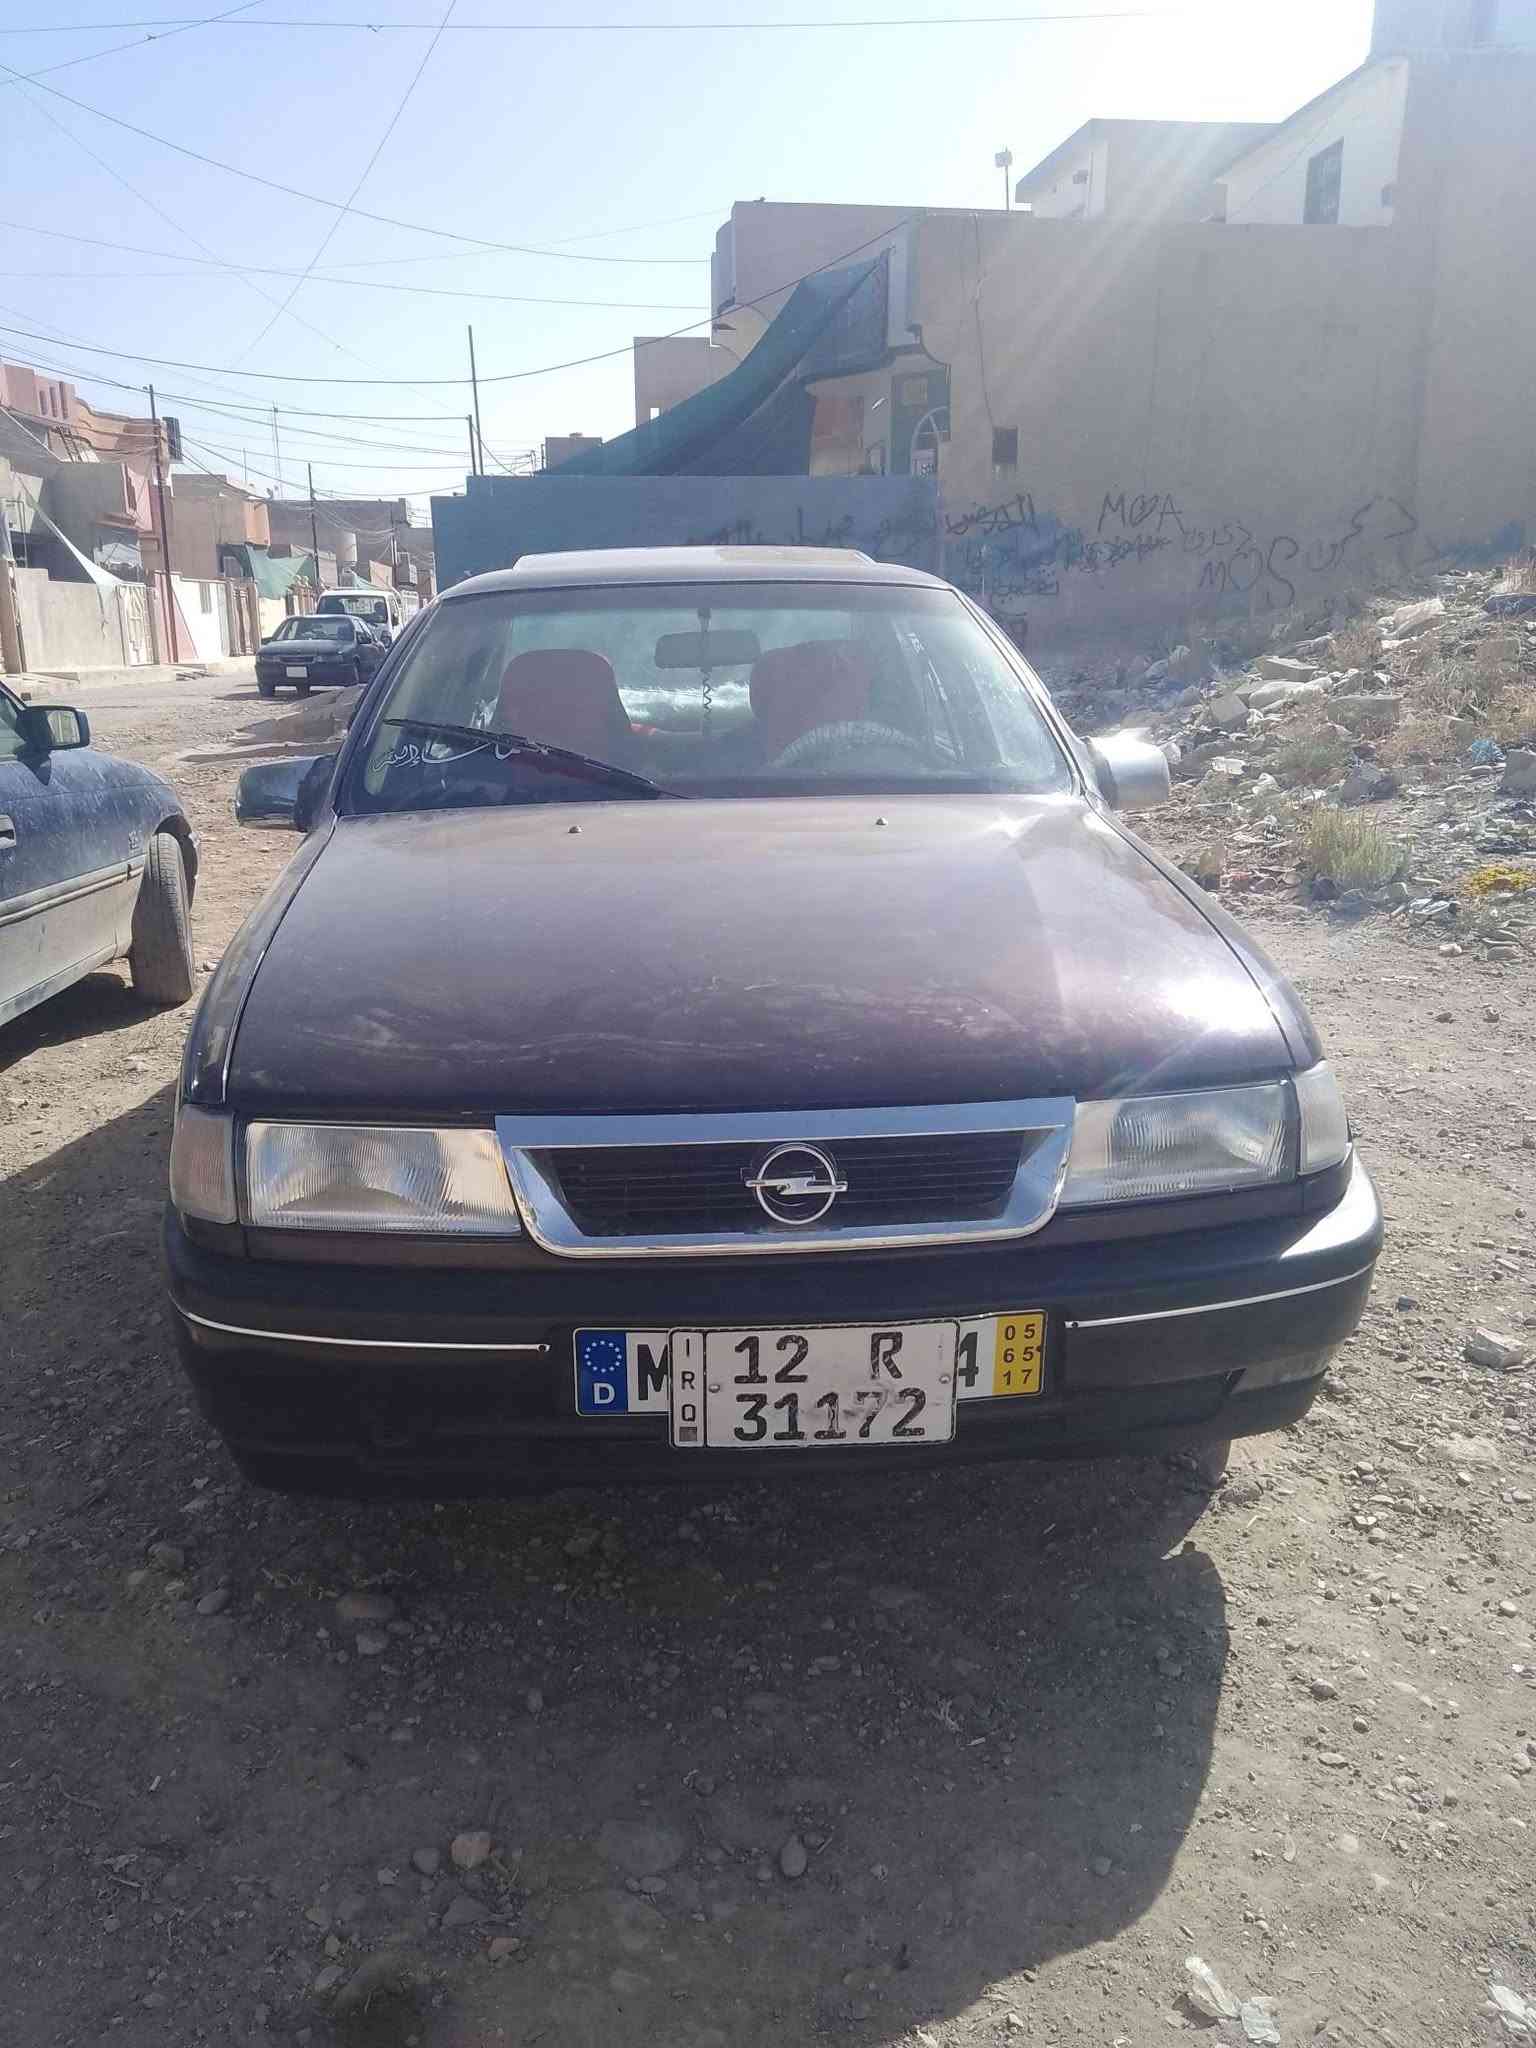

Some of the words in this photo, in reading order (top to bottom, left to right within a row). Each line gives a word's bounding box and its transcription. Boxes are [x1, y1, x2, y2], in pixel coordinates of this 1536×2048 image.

[1004, 1323, 1036, 1340] 05
[734, 1334, 809, 1384] 12
[870, 1331, 903, 1380] R
[1003, 1346, 1034, 1363] 65
[1003, 1368, 1033, 1386] 17
[593, 1382, 616, 1404] D
[734, 1387, 927, 1441] 31172
